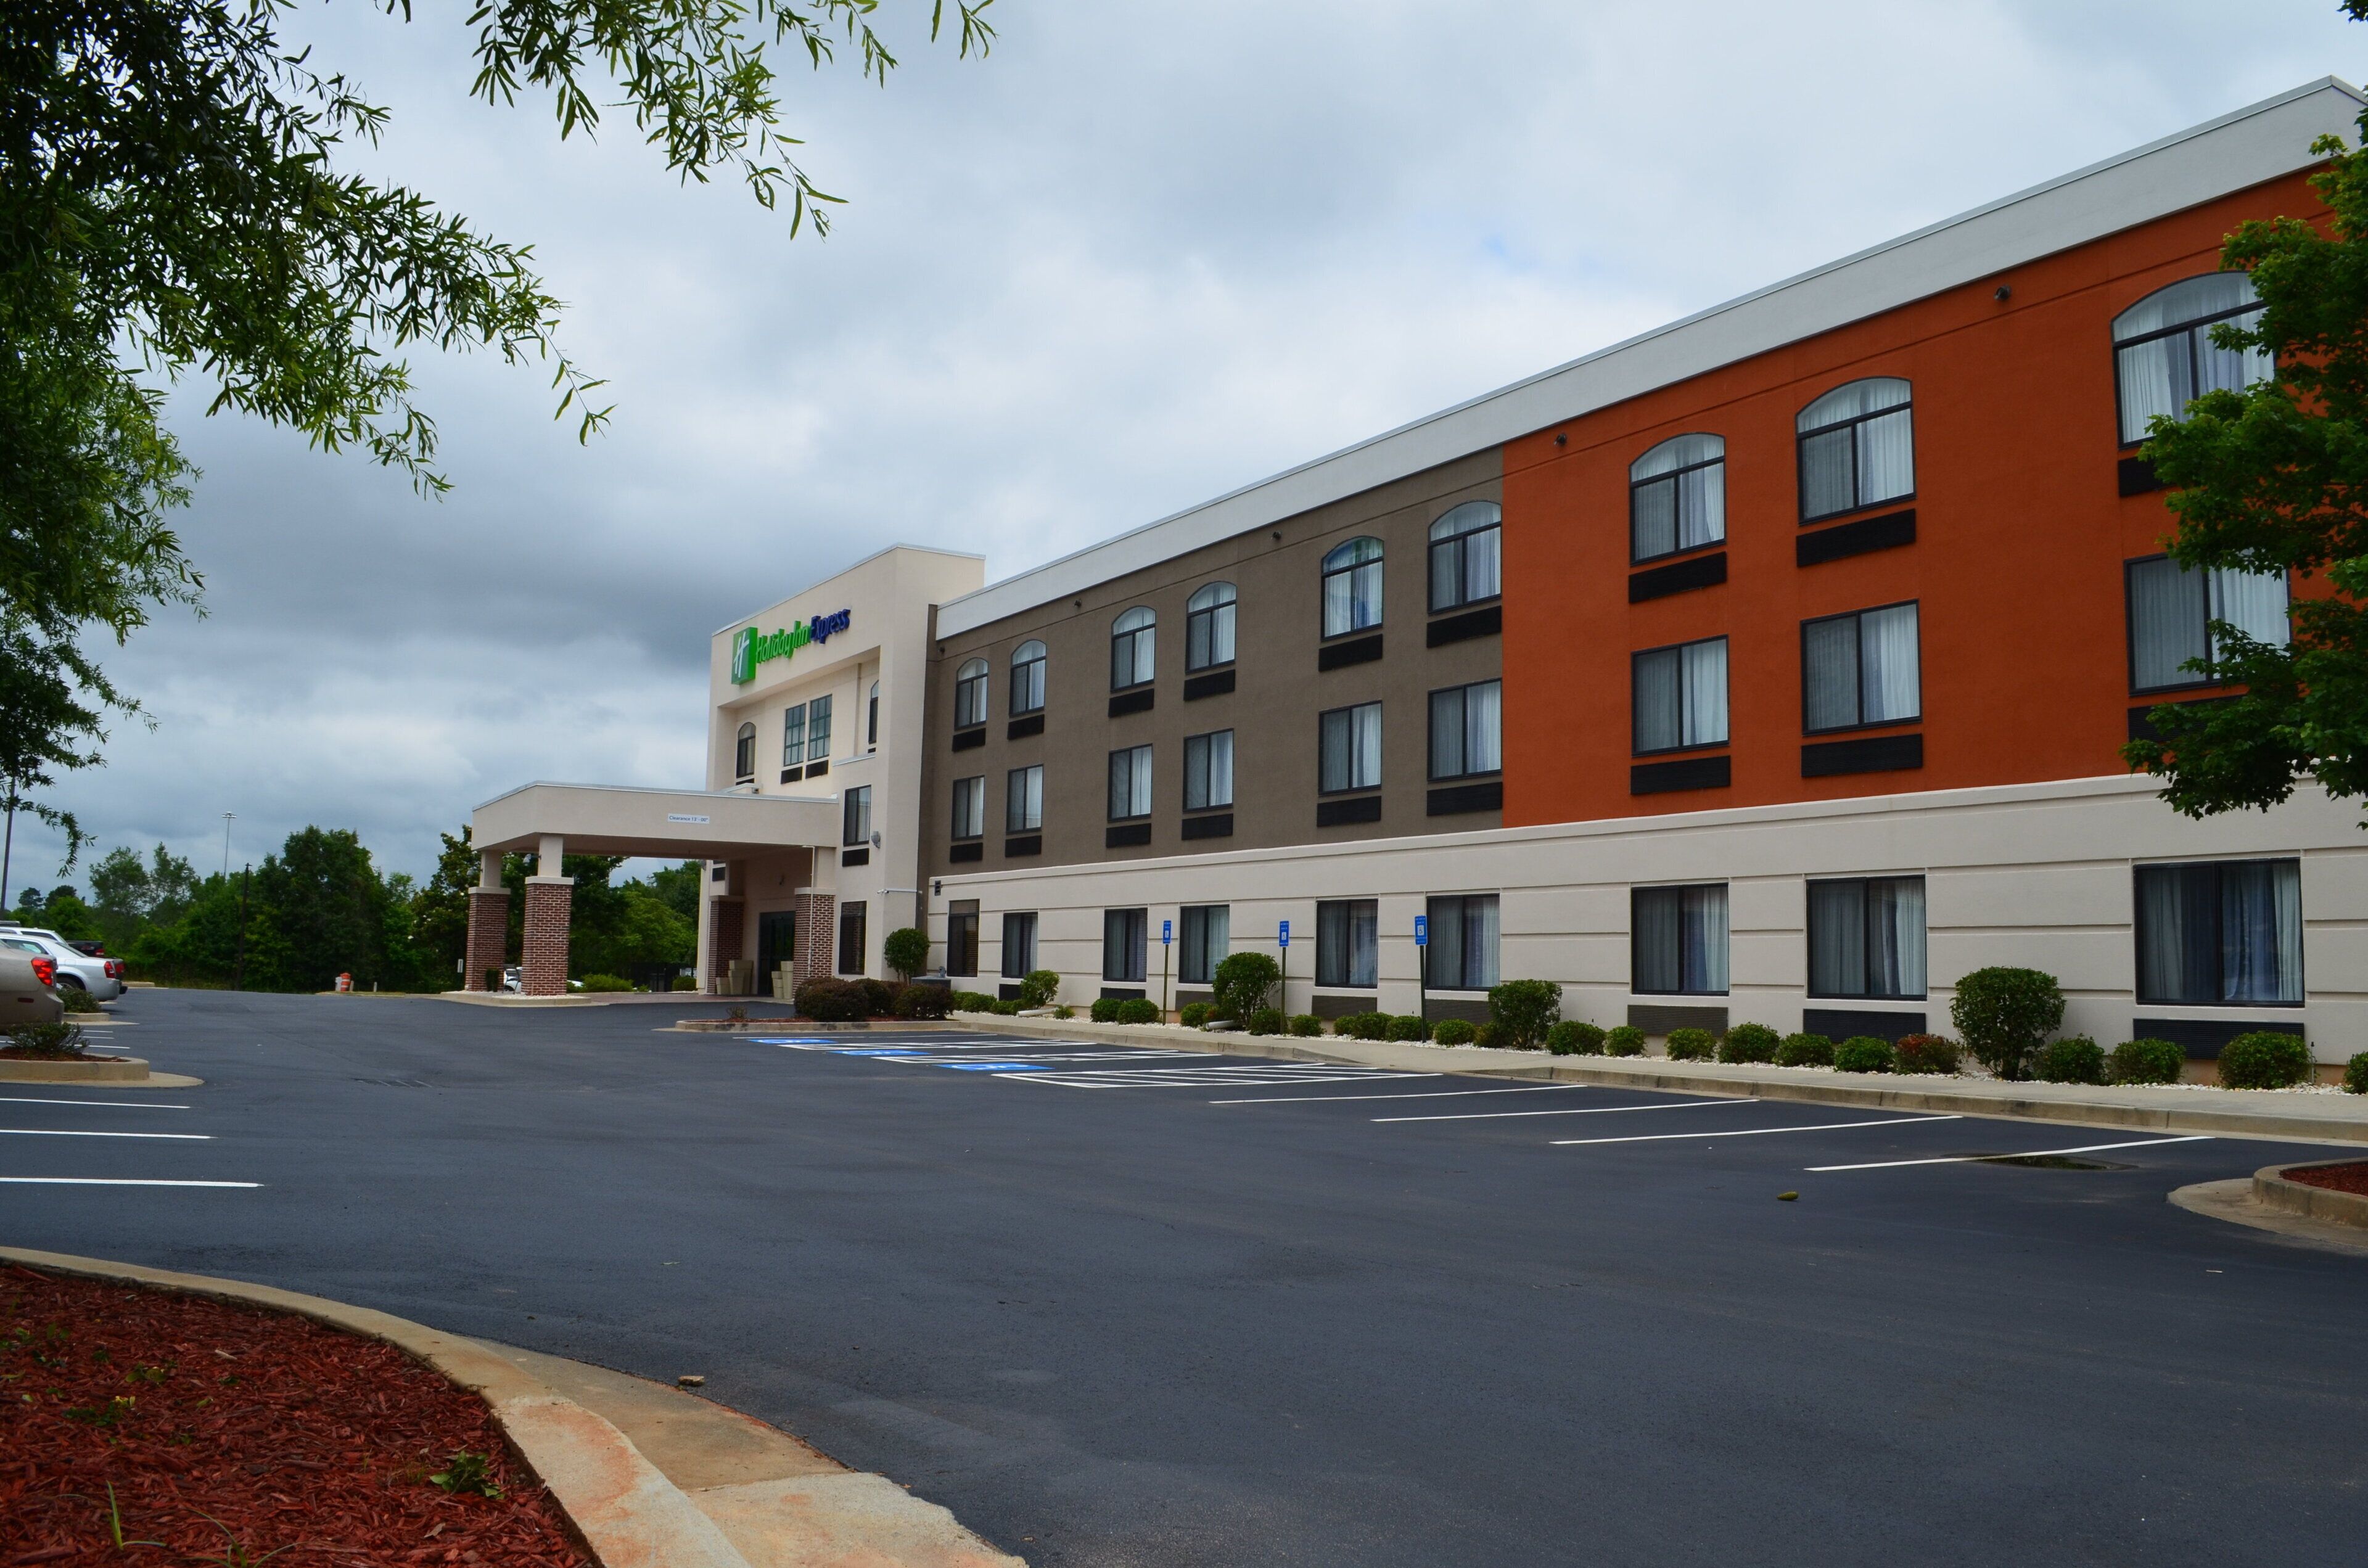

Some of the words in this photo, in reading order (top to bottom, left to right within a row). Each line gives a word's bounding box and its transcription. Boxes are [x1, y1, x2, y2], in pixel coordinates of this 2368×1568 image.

[756, 628, 794, 663] Holiday
[793, 620, 811, 649] Inn
[810, 609, 850, 644] Express
